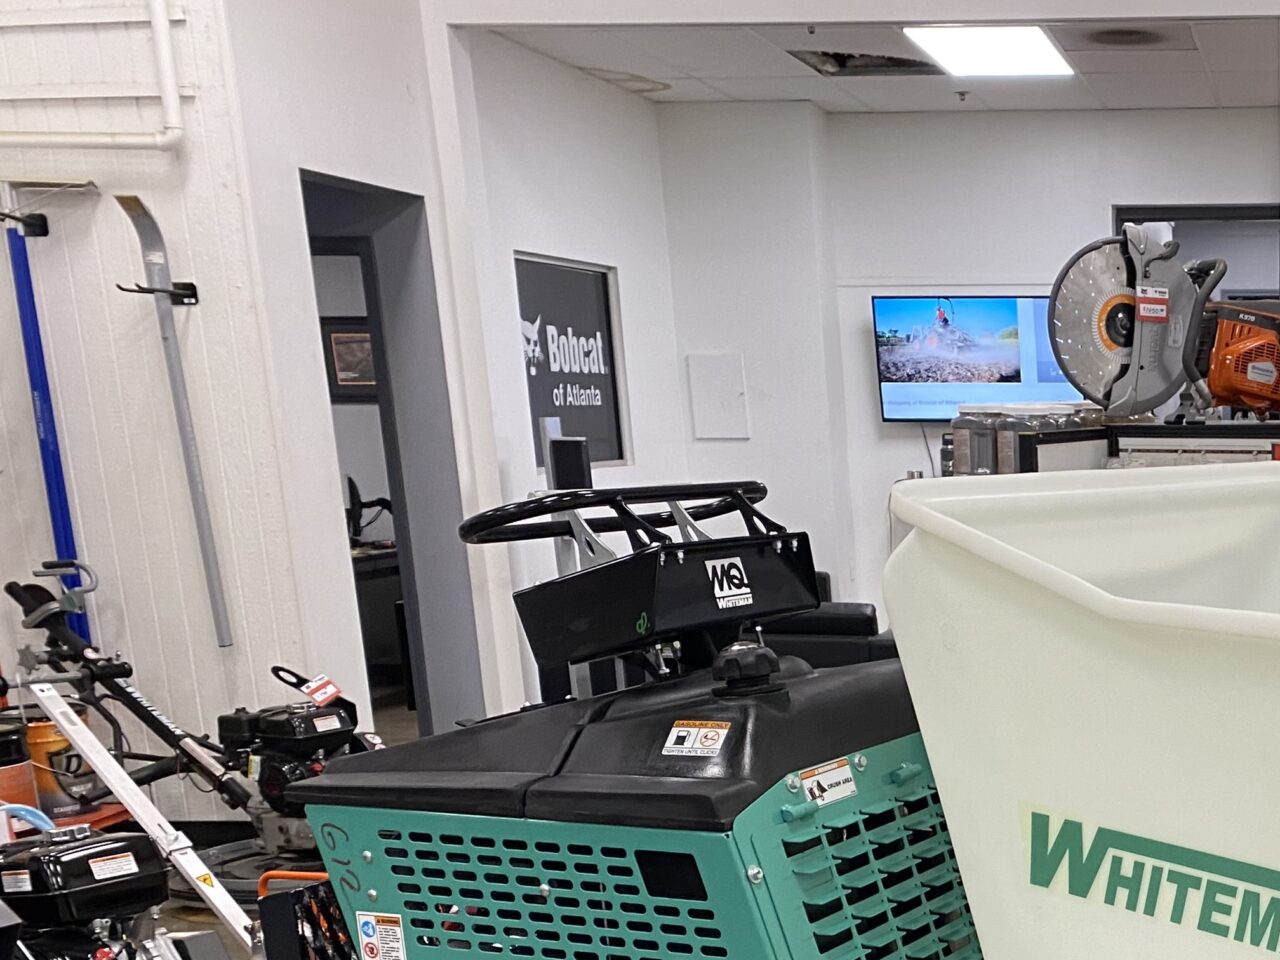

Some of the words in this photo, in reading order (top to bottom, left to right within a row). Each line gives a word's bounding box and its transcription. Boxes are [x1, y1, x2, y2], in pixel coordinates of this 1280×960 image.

[546, 324, 606, 375] Bobcat
[553, 383, 564, 406] of
[566, 383, 602, 406] Atlanta
[711, 561, 750, 592] MQ
